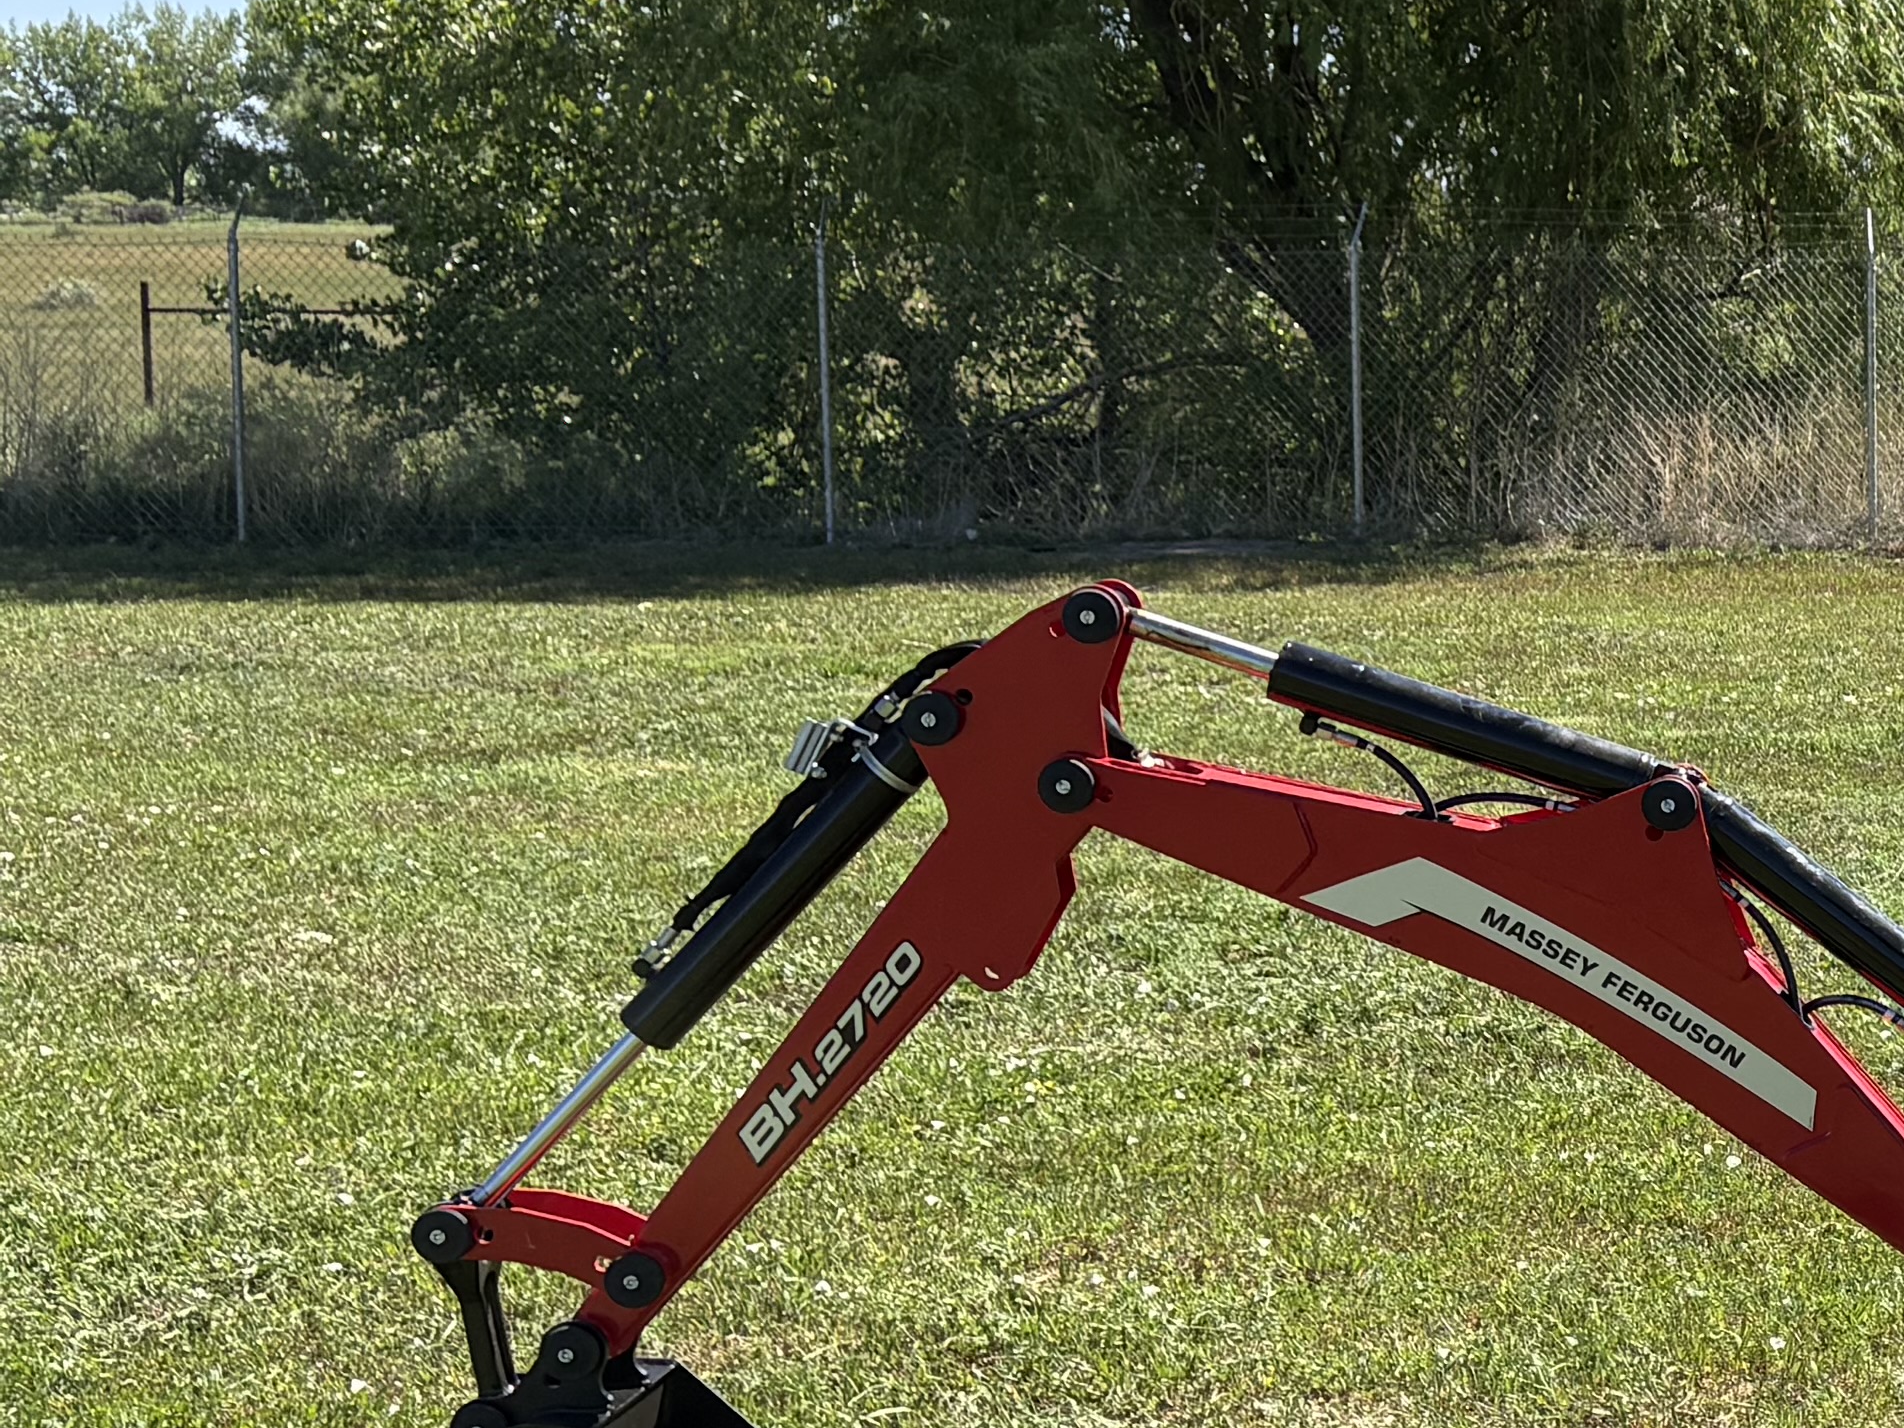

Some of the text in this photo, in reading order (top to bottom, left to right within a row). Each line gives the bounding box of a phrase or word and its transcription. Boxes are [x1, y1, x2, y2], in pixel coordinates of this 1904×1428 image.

[737, 940, 922, 1166] BH.2720
[1479, 905, 1747, 1070] MASSEY FERGUSON
